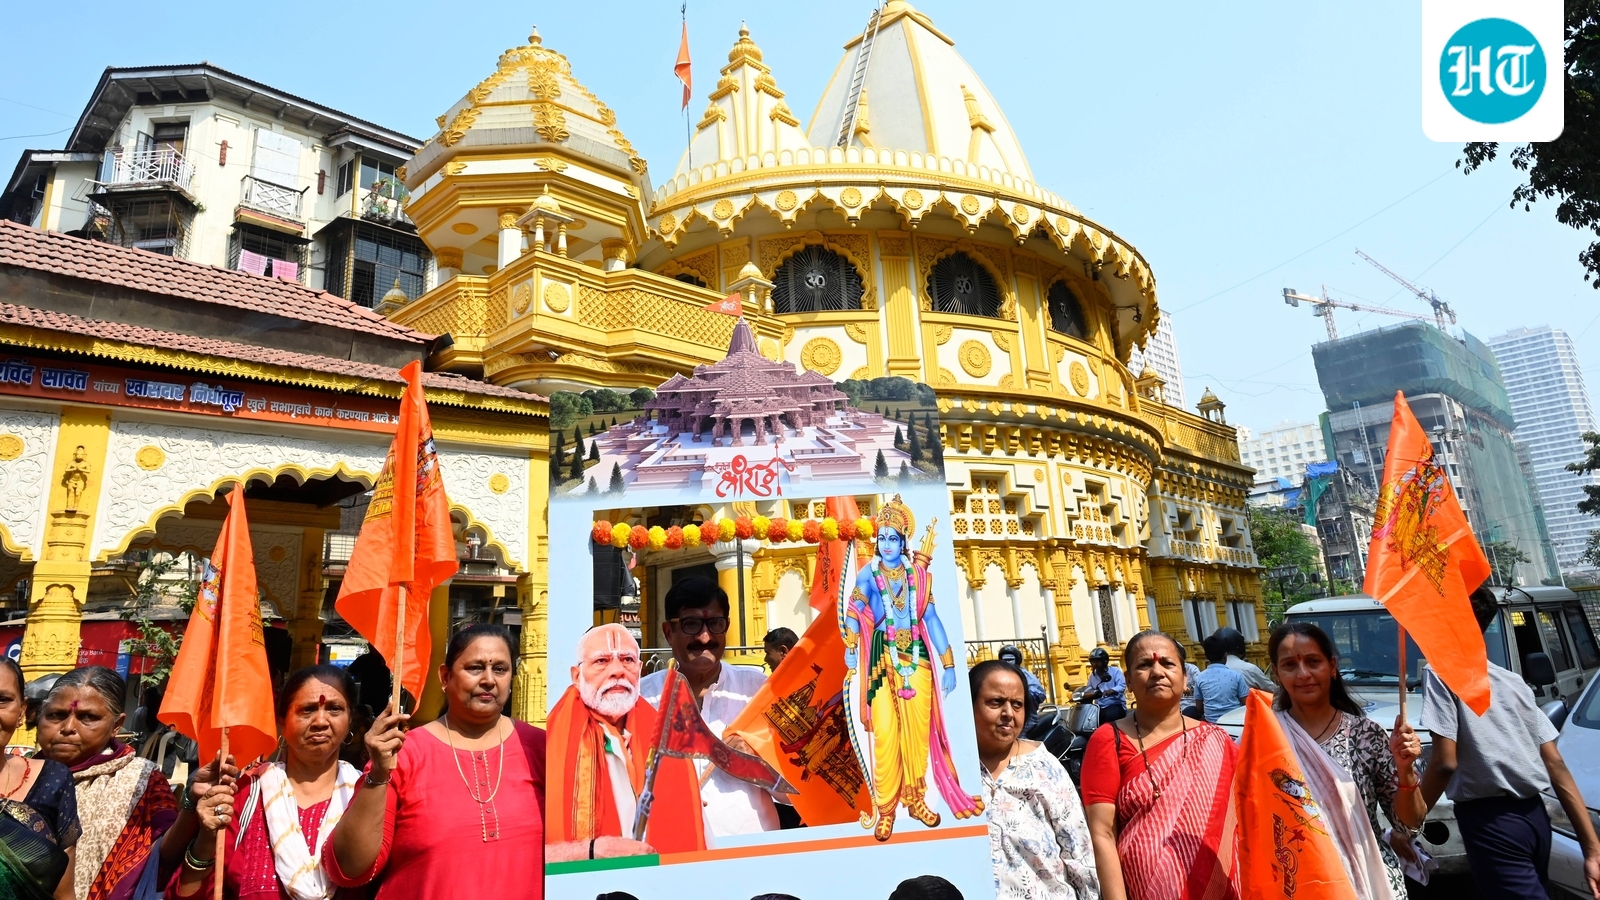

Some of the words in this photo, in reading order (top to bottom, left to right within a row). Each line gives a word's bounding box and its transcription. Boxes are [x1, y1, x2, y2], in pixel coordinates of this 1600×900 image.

[41, 366, 90, 391] सावंत
[93, 379, 120, 393] यांच्या
[125, 378, 186, 401] खासदार
[246, 397, 268, 412] खुले
[270, 400, 313, 418] सभागृहाचे
[314, 406, 334, 418] काम
[336, 408, 370, 422] करण्यात
[371, 411, 390, 424] आले
